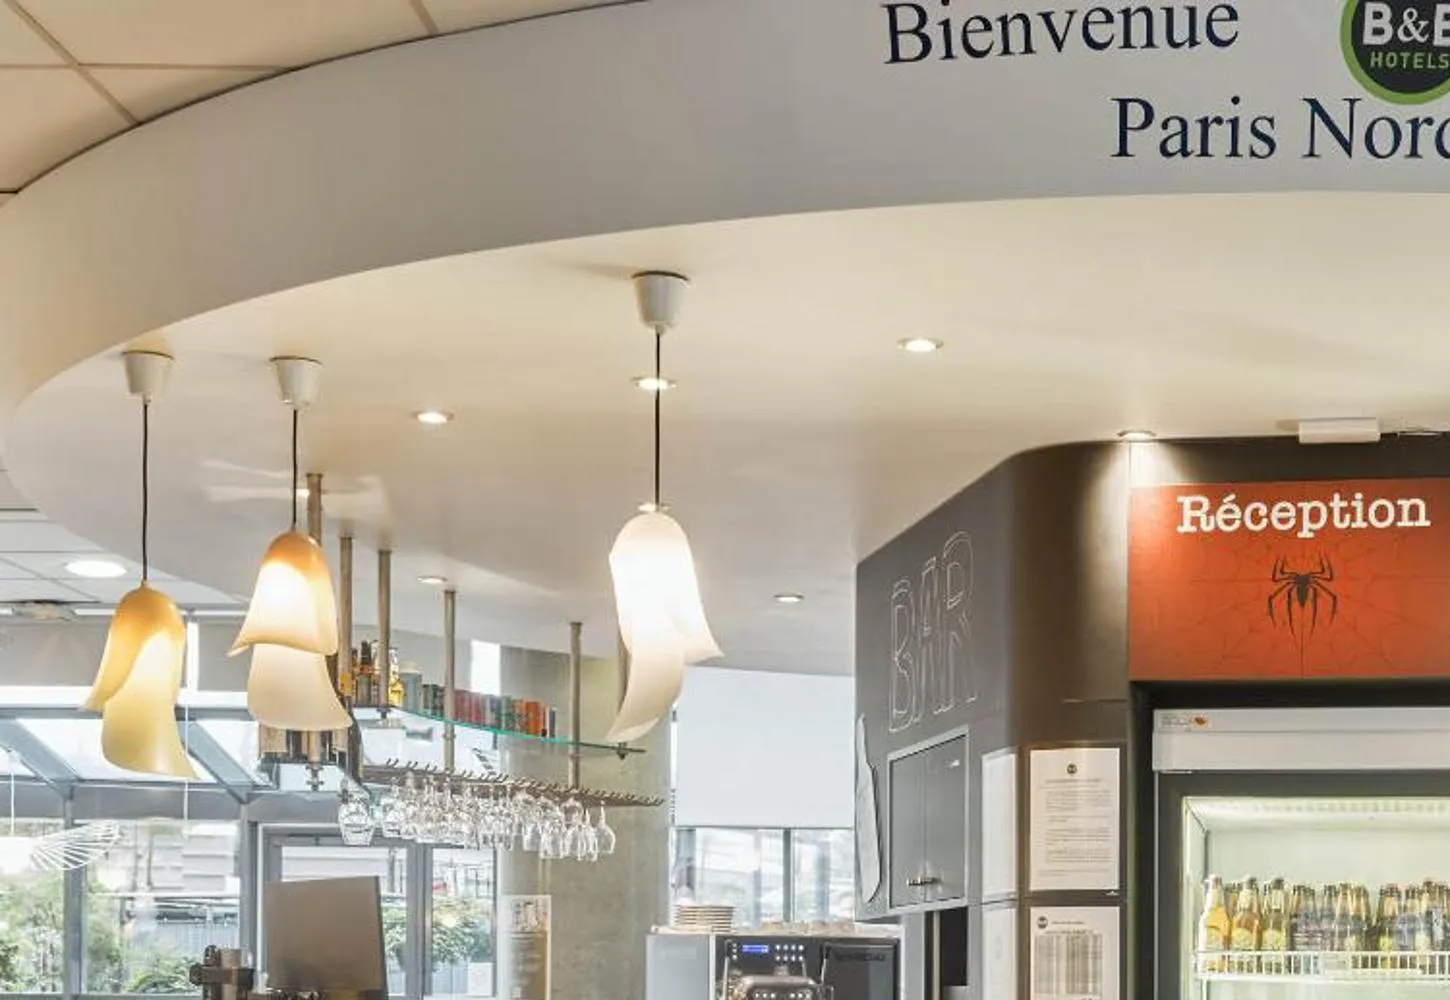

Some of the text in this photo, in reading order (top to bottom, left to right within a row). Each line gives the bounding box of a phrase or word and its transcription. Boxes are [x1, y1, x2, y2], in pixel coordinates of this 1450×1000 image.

[882, 0, 1239, 64] Bienvenue
[1369, 51, 1450, 69] HOTELS
[1110, 96, 1277, 160] Paris
[1176, 492, 1431, 539] Réception
[889, 531, 977, 732] BAR
